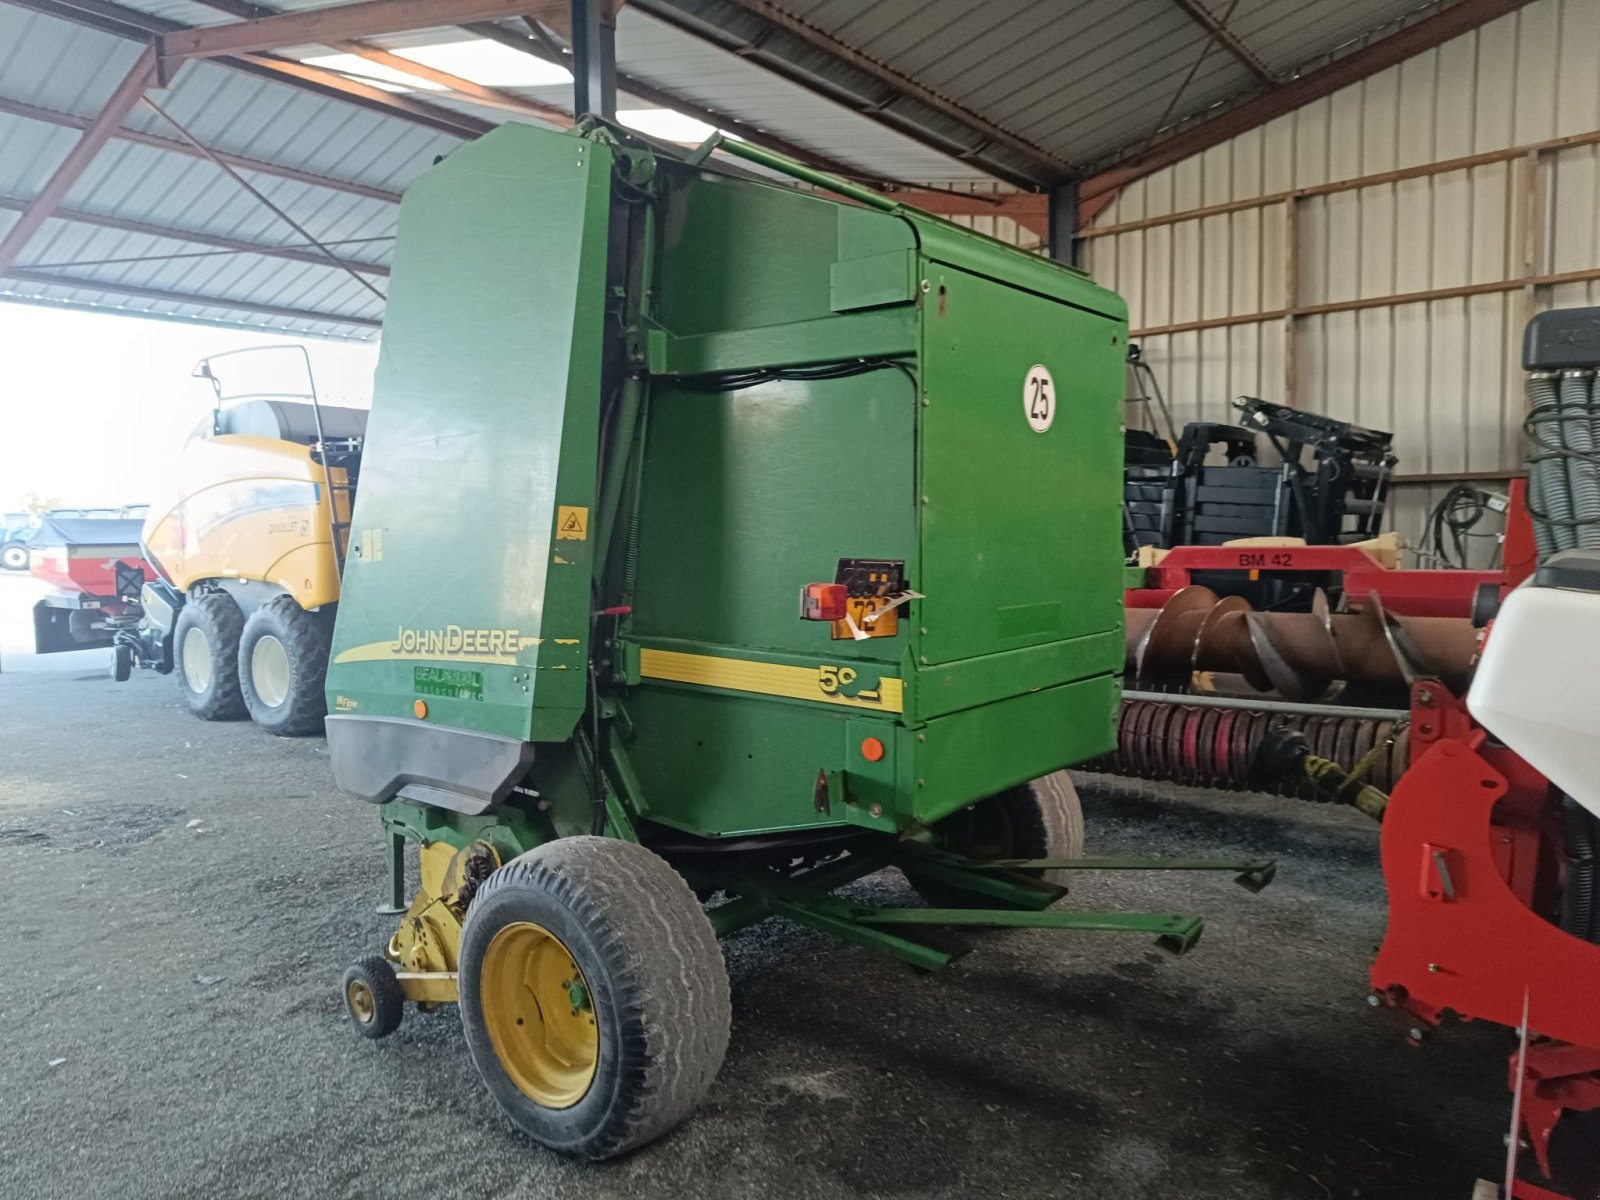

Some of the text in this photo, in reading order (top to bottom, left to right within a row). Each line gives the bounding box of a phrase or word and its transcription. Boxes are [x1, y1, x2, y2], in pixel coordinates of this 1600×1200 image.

[1030, 376, 1049, 421] 25
[1239, 553, 1292, 567] BM 42
[392, 624, 519, 657] JOHN DEERE
